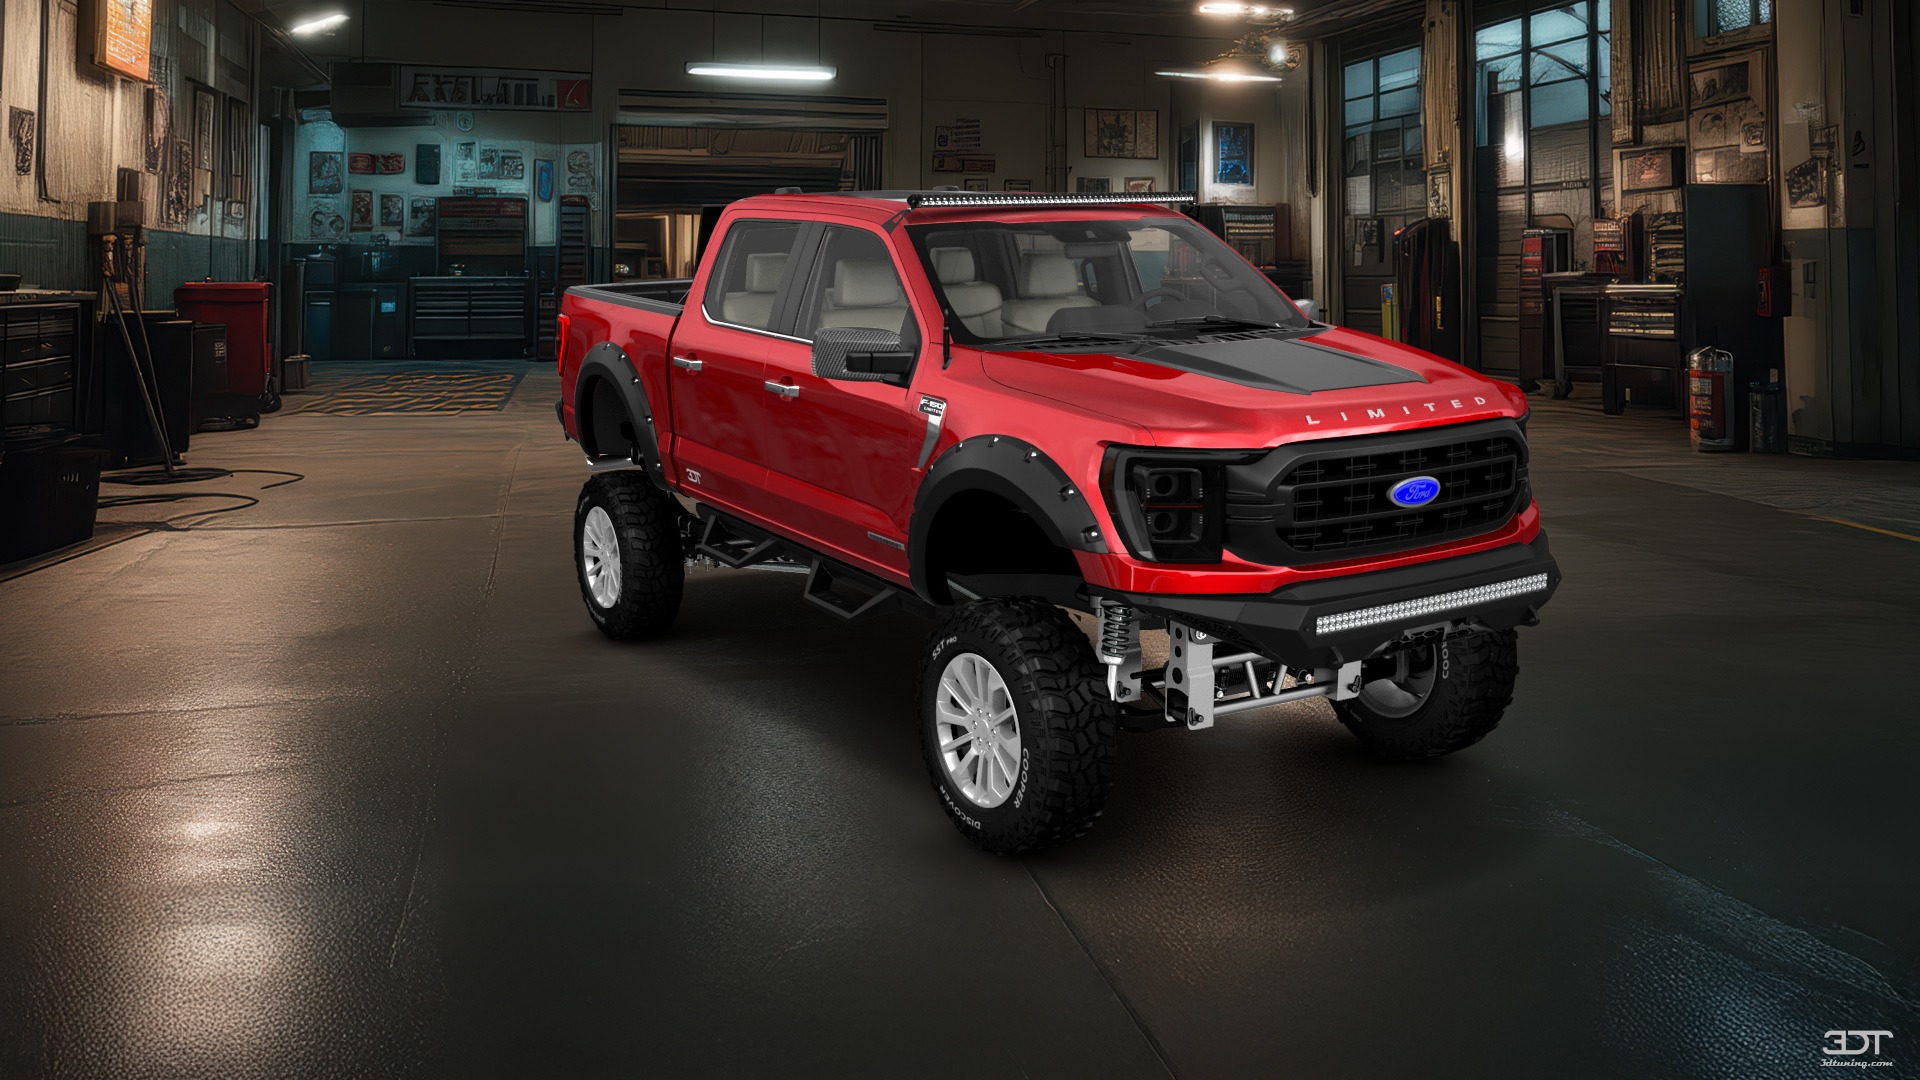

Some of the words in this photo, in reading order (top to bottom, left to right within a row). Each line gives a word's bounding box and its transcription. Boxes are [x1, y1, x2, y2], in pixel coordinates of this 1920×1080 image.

[1305, 396, 1486, 425] LIMITED
[1405, 484, 1432, 500] Ford
[932, 639, 945, 660] SST
[1013, 747, 1029, 808] COOPER
[939, 784, 981, 829] DISCOVER
